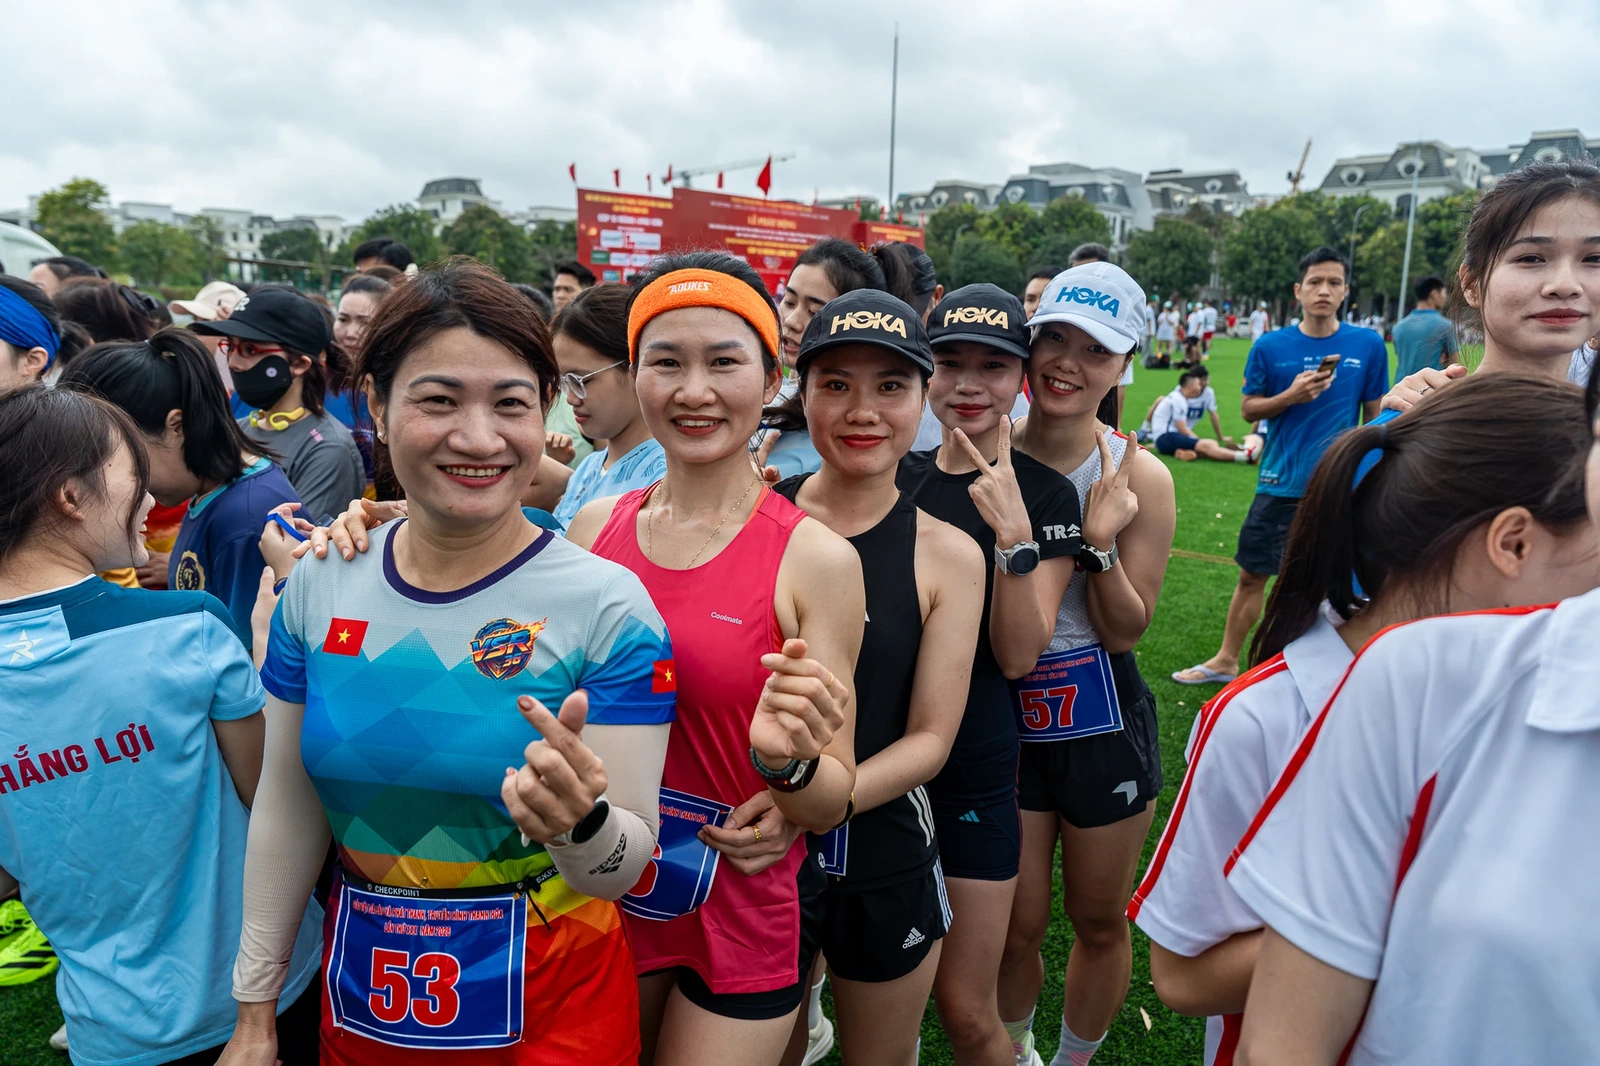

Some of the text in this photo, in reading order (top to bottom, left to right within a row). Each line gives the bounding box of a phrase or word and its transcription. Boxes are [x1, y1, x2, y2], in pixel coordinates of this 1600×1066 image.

[1055, 286, 1120, 318] HOKA
[829, 311, 907, 339] HOKA
[943, 307, 1009, 330] HOKA
[710, 611, 743, 625] Coolmate
[471, 629, 531, 662] VSR
[1019, 684, 1079, 731] 57
[94, 722, 156, 764] LỢI
[374, 885, 420, 897] CHECKPOINT
[490, 907, 504, 919] HÓA
[420, 924, 435, 936] NĂM
[902, 934, 926, 949] adidas
[368, 947, 461, 1028] 53
